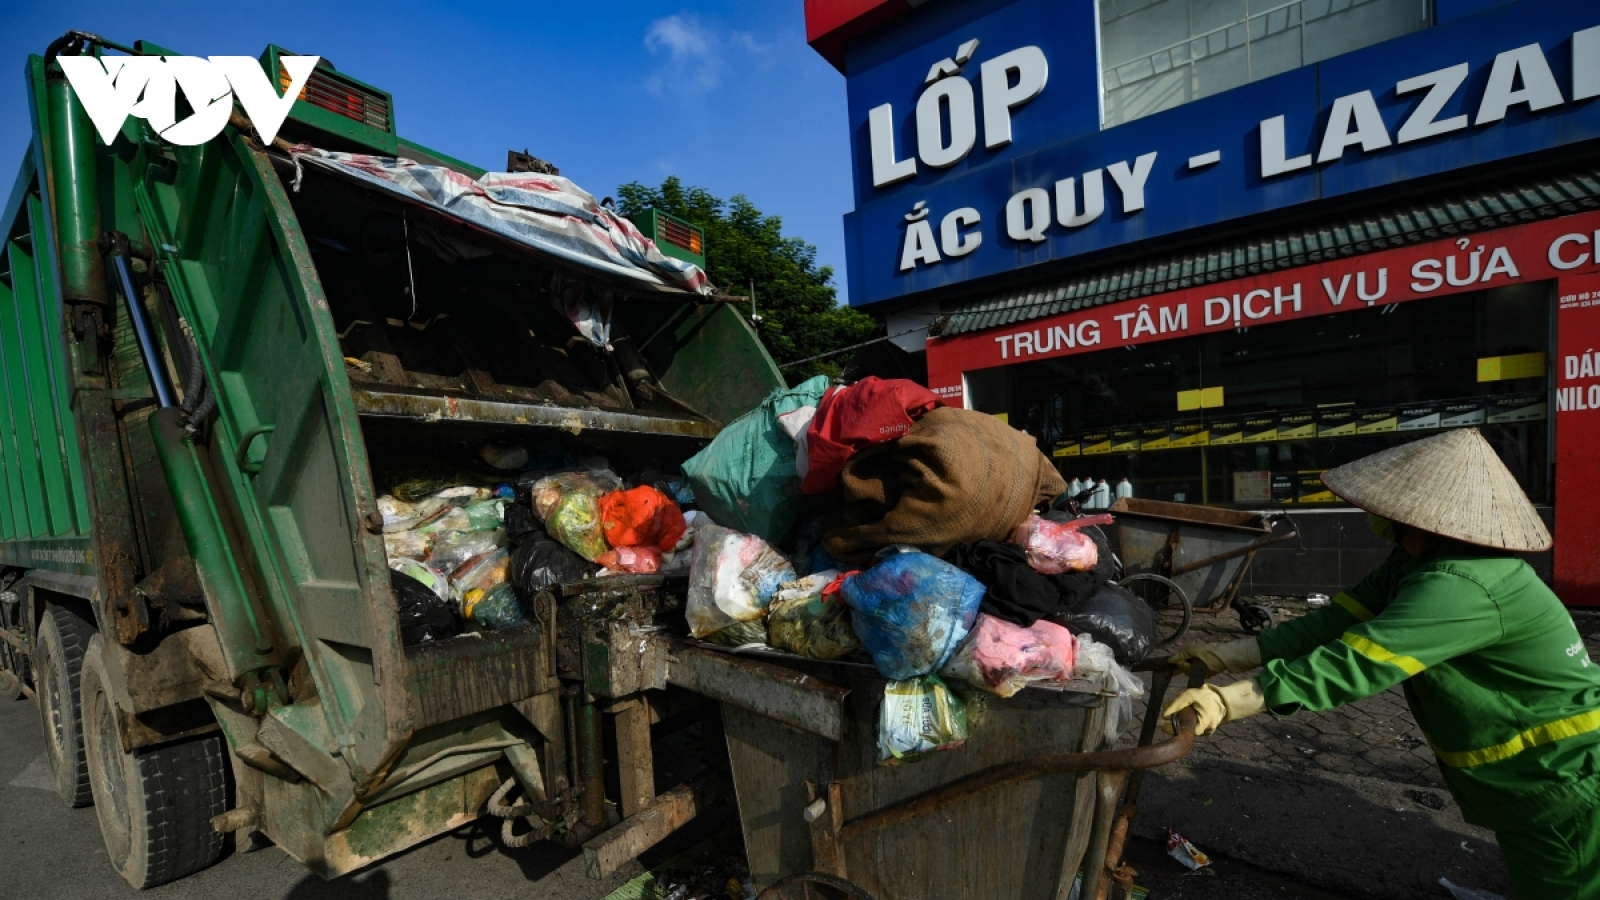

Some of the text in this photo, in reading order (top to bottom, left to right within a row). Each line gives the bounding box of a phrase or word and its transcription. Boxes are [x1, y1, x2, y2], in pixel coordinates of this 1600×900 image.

[868, 38, 1050, 188] LỐP
[899, 200, 982, 271] ẮC
[1005, 151, 1158, 243] QUY
[1188, 150, 1221, 170] -
[994, 228, 1600, 360] TRUNG TÂM DỊCH VỤ SỬA C
